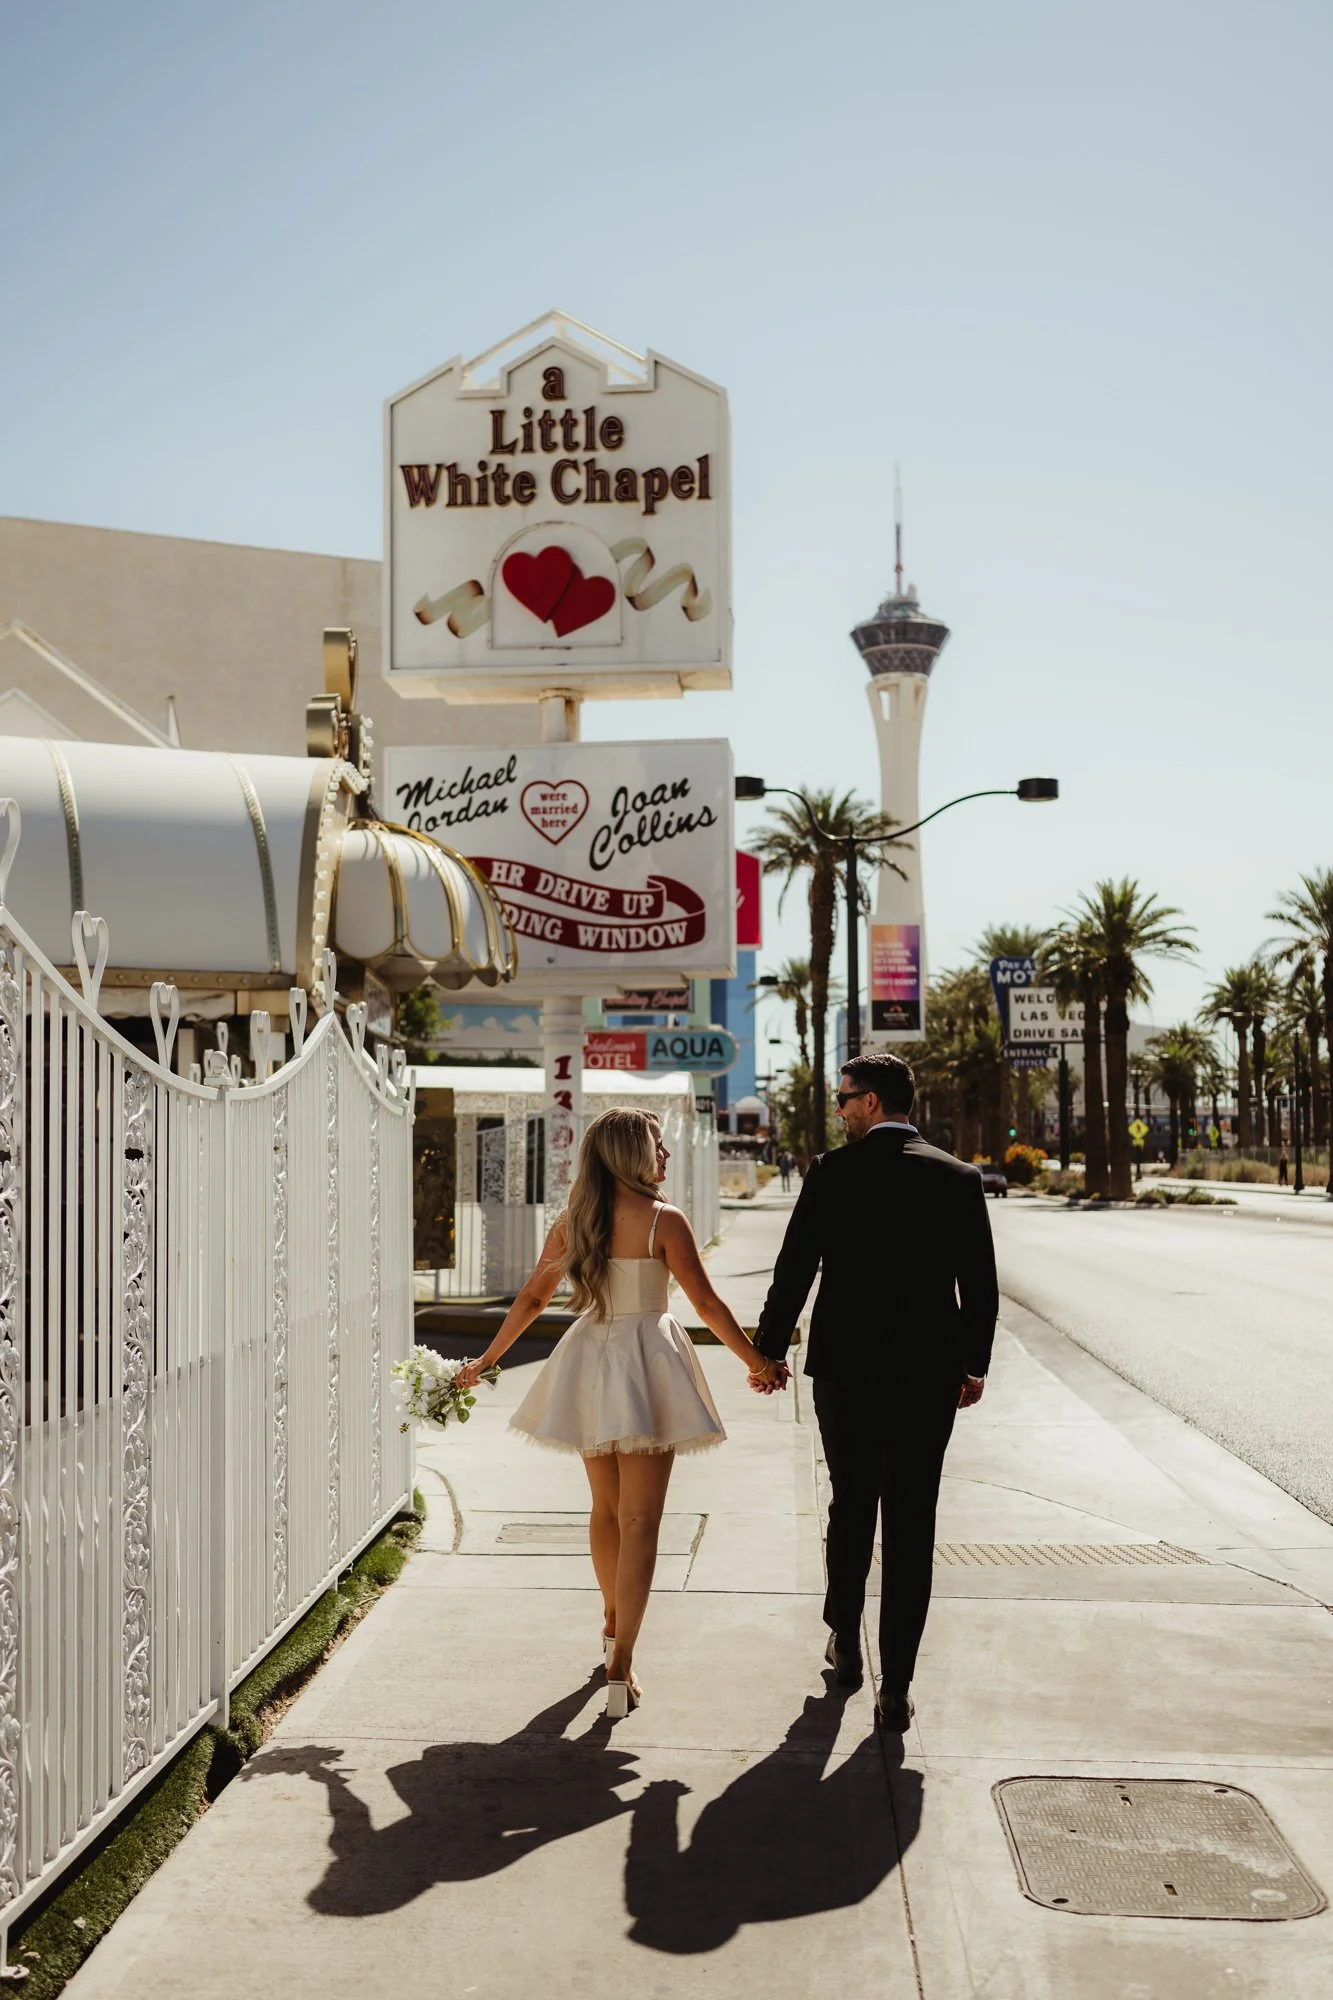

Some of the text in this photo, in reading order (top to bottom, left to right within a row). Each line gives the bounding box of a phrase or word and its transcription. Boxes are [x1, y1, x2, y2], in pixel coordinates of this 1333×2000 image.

[541, 365, 567, 400] a
[489, 405, 625, 455] Little
[400, 454, 712, 516] White Chapel
[396, 754, 517, 810] Michael
[540, 791, 568, 801] were
[407, 796, 509, 832] Jordan
[530, 803, 578, 816] married
[541, 816, 568, 828] here
[611, 777, 691, 833] Joan
[589, 805, 718, 871] Collins
[490, 861, 655, 917] HR DRIVE UP
[500, 902, 688, 949] DING WINDOW
[996, 970, 1036, 984] MOT
[1020, 1011, 1048, 1021] LAS
[652, 1037, 724, 1060] AQUA
[1013, 1029, 1055, 1039] DRIVE
[587, 1053, 638, 1069] OTEL
